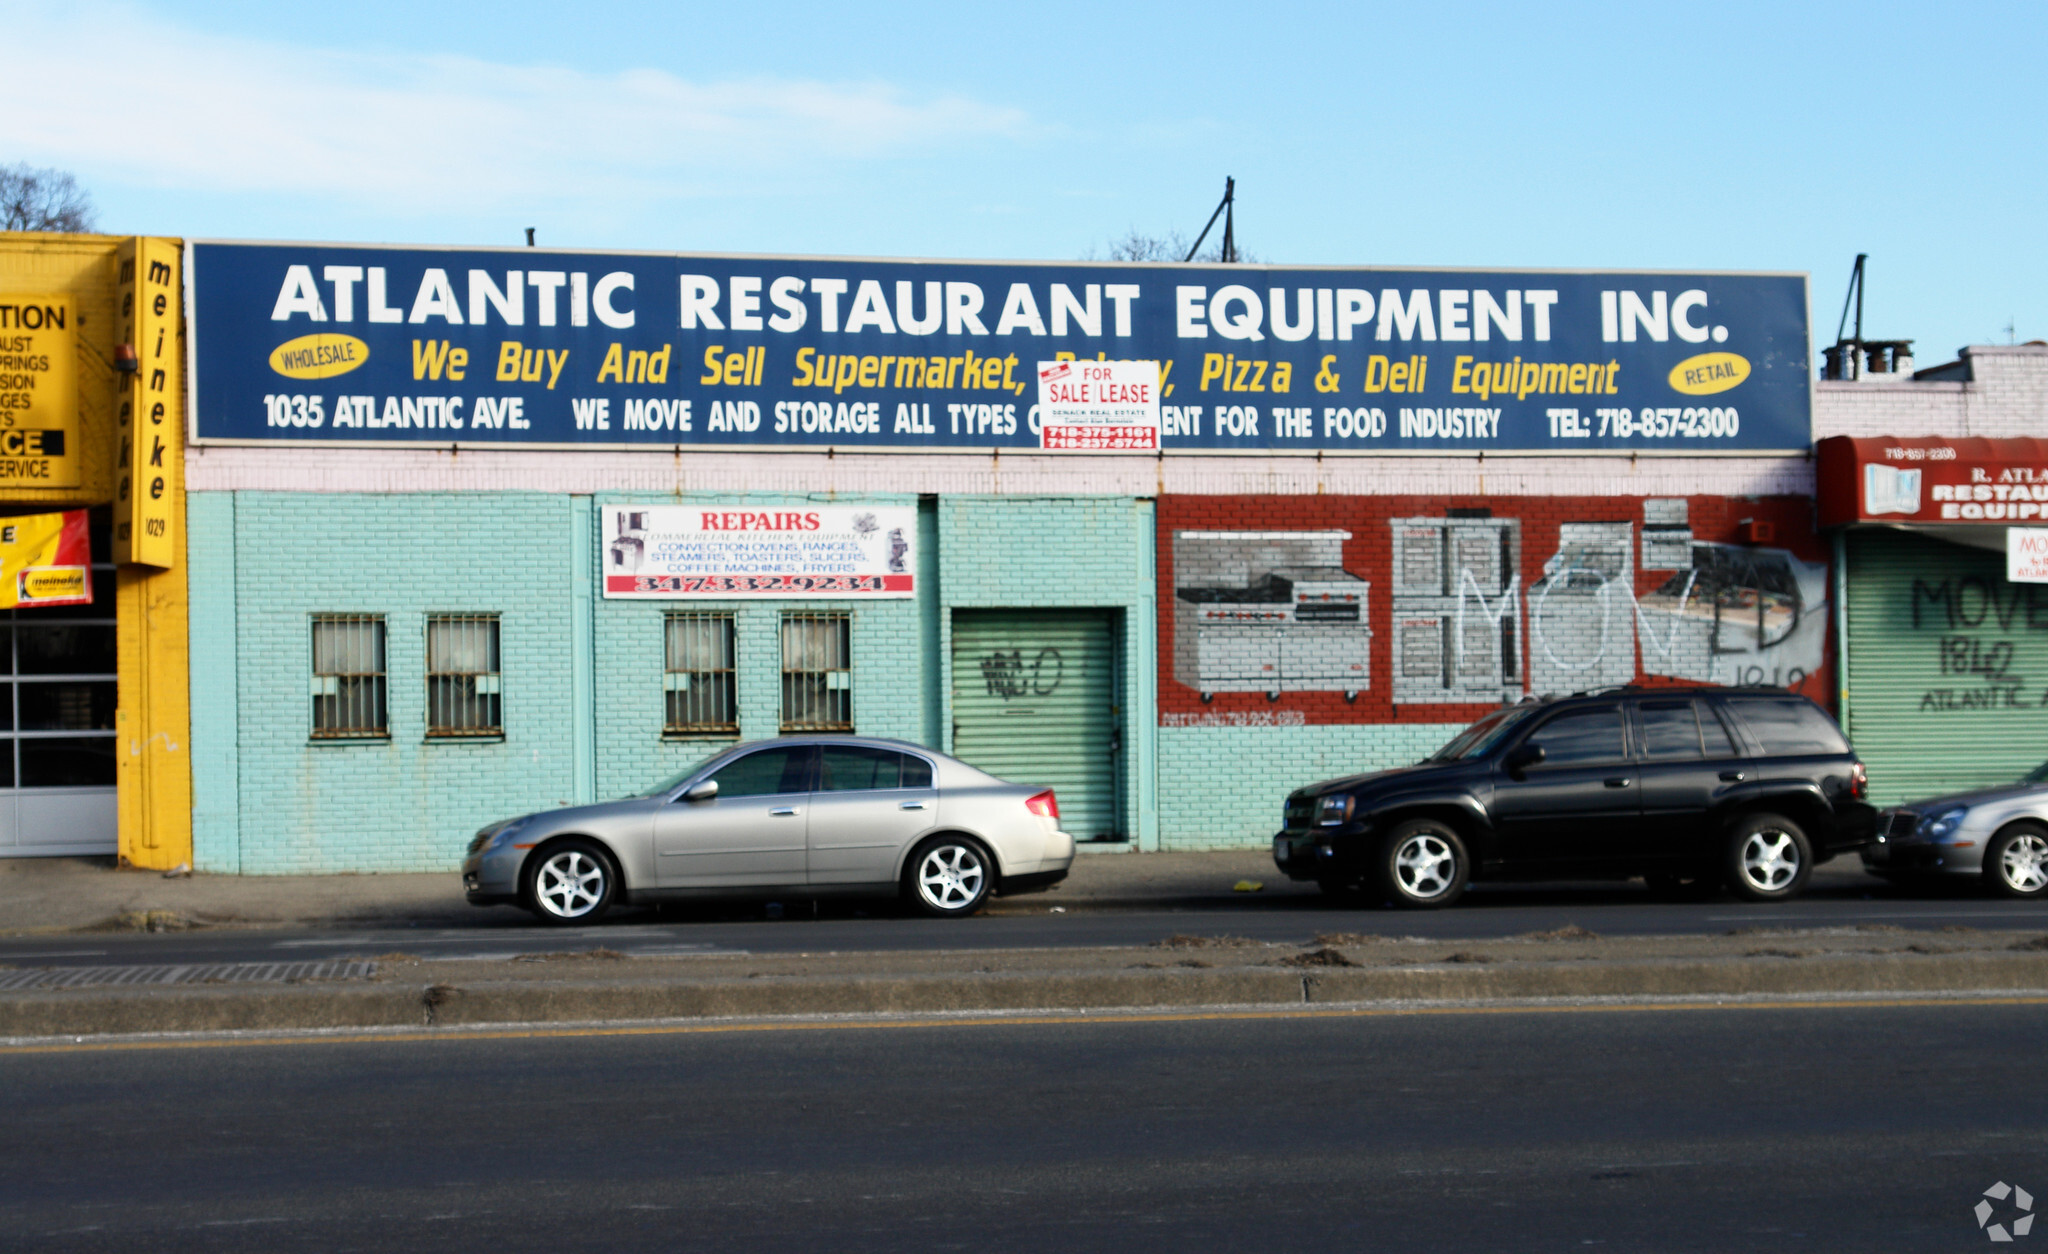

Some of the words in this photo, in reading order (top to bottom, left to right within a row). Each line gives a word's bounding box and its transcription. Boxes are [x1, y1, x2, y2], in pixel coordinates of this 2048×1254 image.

[272, 265, 636, 329] ATLANTIC
[680, 275, 1141, 338] RESTAURANT
[1176, 285, 1560, 343] EQUIPMENT
[1600, 289, 1730, 343] INC.
[0, 337, 32, 351] UST
[281, 342, 355, 370] WHOLESALE
[149, 259, 171, 499] meineke
[412, 339, 470, 381] We
[495, 341, 569, 390] Buy
[596, 343, 672, 385] And
[701, 345, 767, 386] Sell
[792, 346, 1027, 396] Supermarket,
[1200, 353, 1293, 394] Pizza
[1315, 355, 1341, 394] &
[1364, 355, 1429, 393] Deli
[1451, 356, 1621, 401] Equipment
[1084, 368, 1112, 381] FOR
[1685, 361, 1739, 386] RETAIL
[1050, 384, 1089, 403] SALE
[1100, 384, 1149, 403] LEASE
[263, 394, 325, 428] 1035
[332, 395, 465, 429] ATLANTIC
[471, 397, 531, 430] AVE.
[571, 398, 611, 430] WE
[623, 399, 693, 432] MOVE
[707, 400, 761, 432] AND
[774, 401, 881, 434] STORAGE
[893, 403, 937, 435] ALL
[947, 403, 1018, 436] TYPES
[1215, 405, 1260, 437] FOR
[1272, 407, 1314, 438] THE
[1324, 407, 1388, 438] FOOD
[1399, 408, 1503, 438] INDUSTRY
[1546, 408, 1591, 438] TEL:
[1596, 407, 1740, 438] 718-857-2300
[1941, 502, 2048, 520] EQUIP
[145, 518, 165, 537] 1029
[700, 512, 820, 531] REPAIRS
[658, 542, 750, 552] CONVECTION
[667, 563, 720, 573] COFFEE
[802, 563, 856, 573] FRYERS
